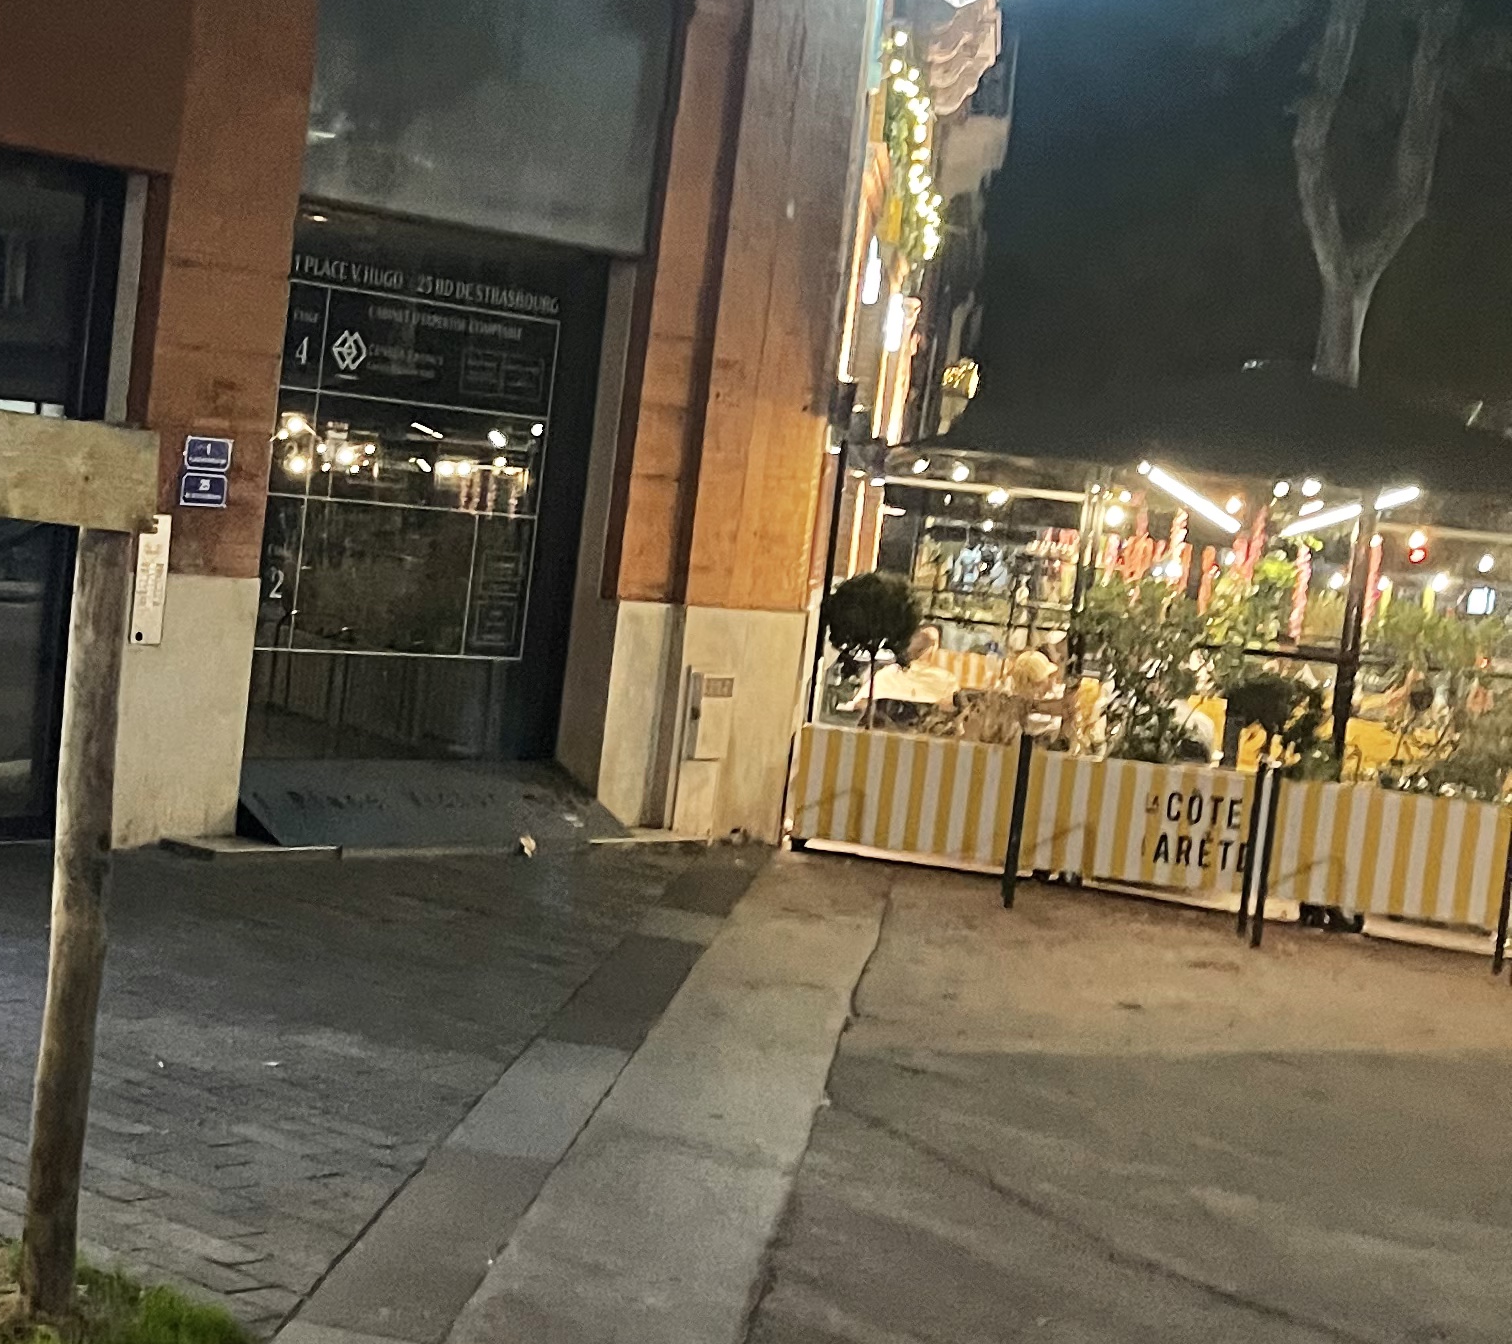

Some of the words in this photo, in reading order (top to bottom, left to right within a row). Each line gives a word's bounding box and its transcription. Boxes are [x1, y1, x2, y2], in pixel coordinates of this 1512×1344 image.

[305, 256, 348, 281] PLACE
[363, 265, 403, 289] HUGO
[476, 283, 559, 315] STRASBOURG
[295, 336, 310, 365] 4
[269, 567, 285, 599] 2
[1166, 787, 1243, 829] CÔTE
